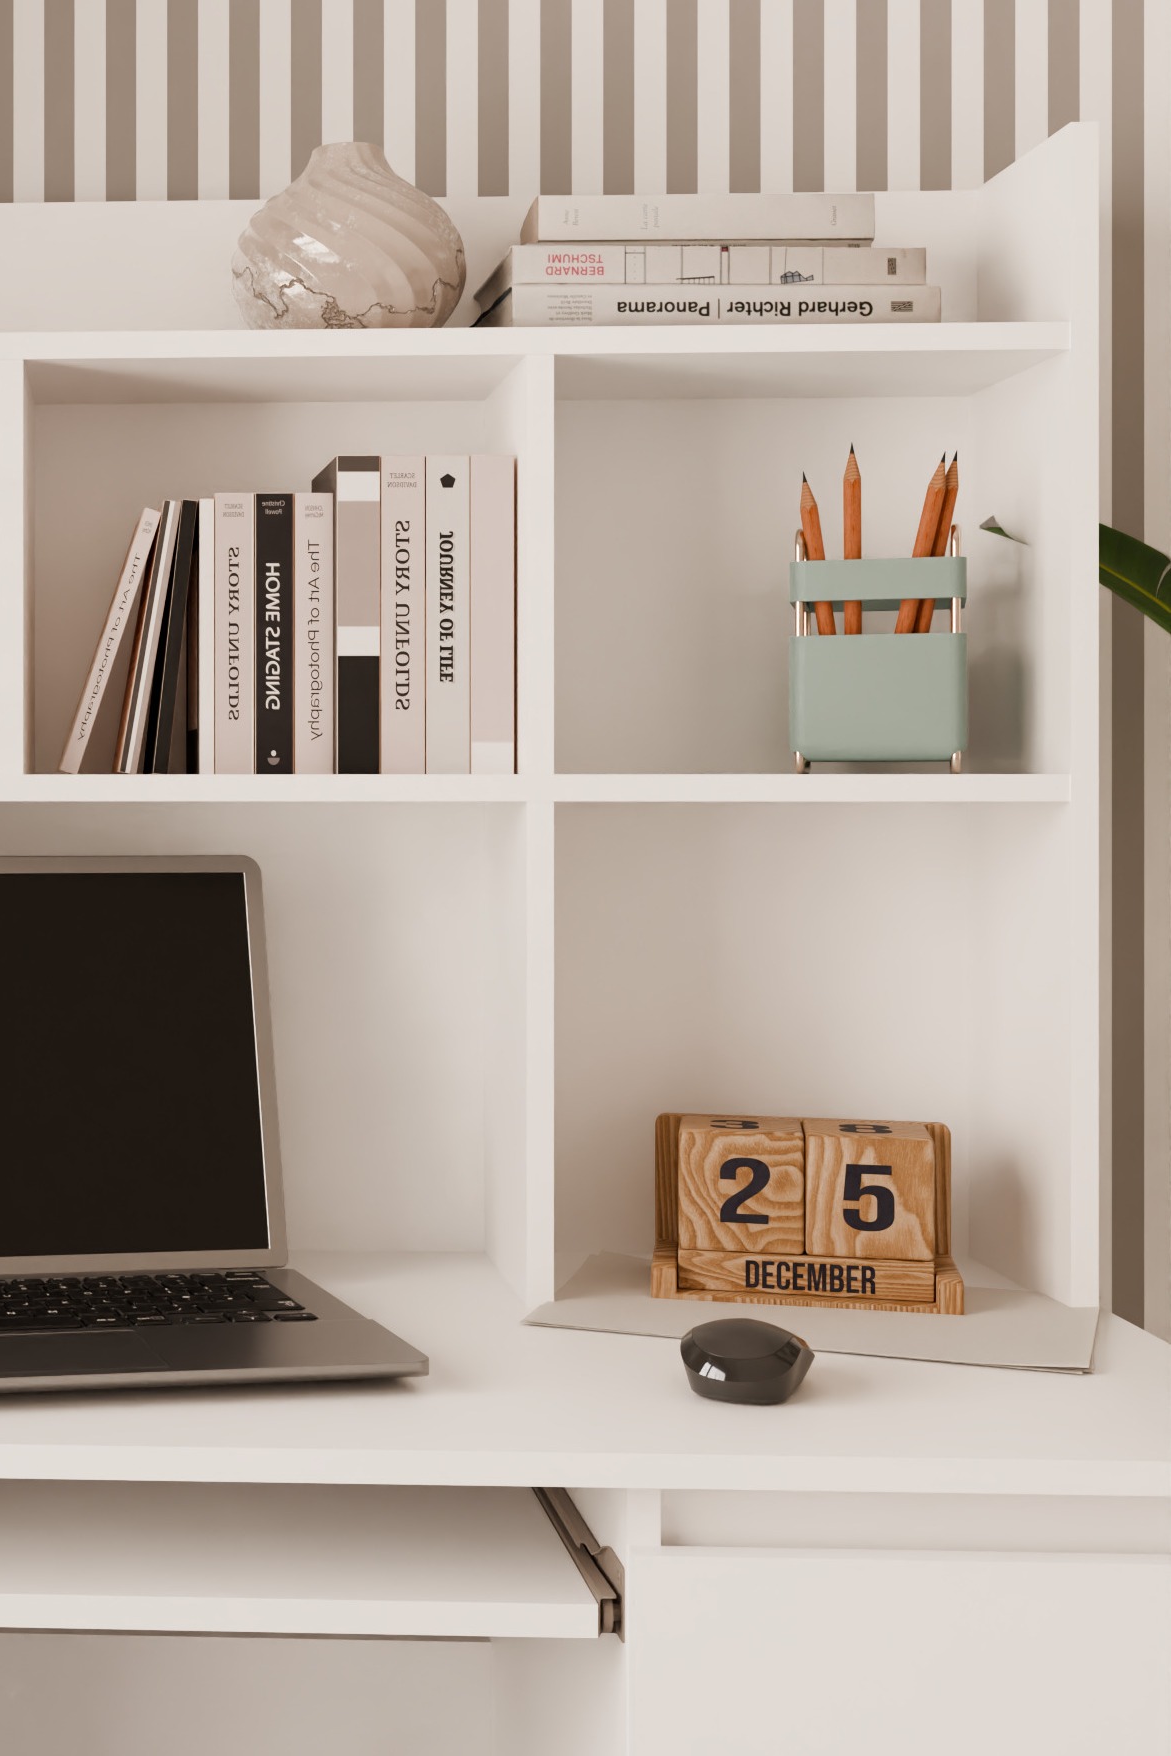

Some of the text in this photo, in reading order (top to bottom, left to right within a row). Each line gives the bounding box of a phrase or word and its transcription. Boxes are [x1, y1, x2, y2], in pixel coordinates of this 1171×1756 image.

[547, 254, 604, 264] TSCHUMI
[545, 266, 605, 276] BERNARD
[617, 301, 873, 317] Gerhard Richter Panorama
[720, 1157, 895, 1232] 2 5
[745, 1260, 876, 1294] DECEMBER
